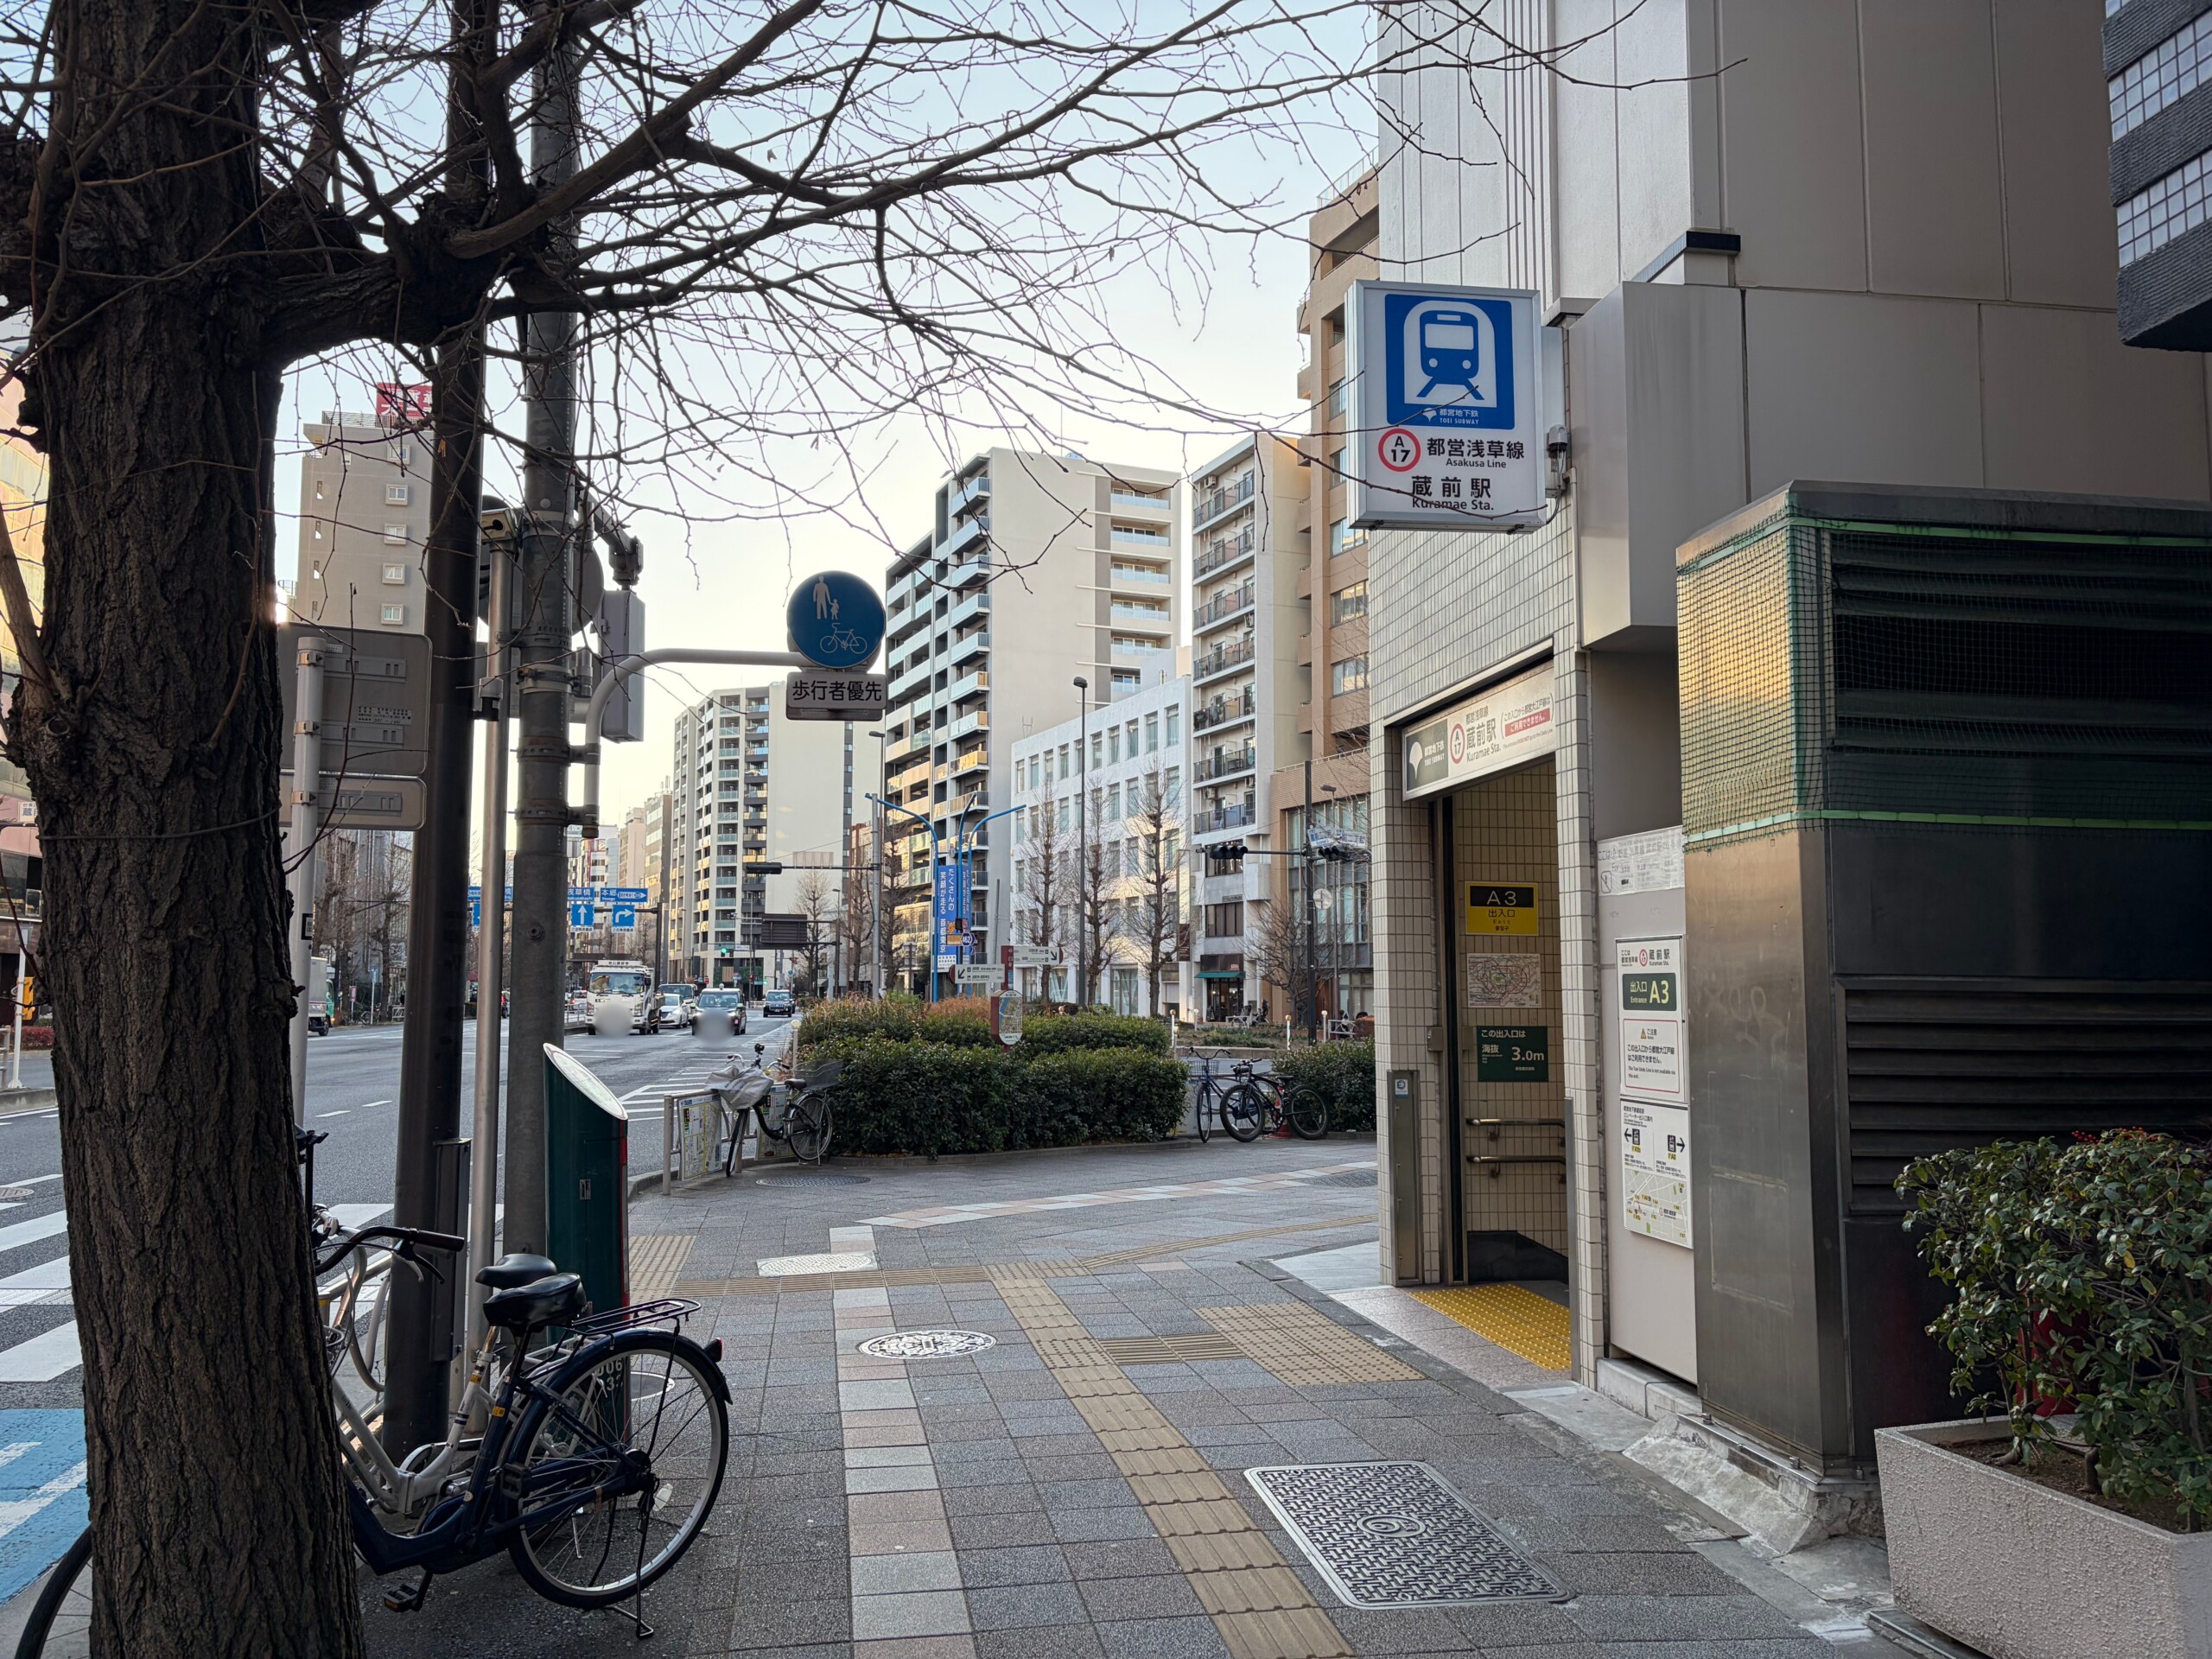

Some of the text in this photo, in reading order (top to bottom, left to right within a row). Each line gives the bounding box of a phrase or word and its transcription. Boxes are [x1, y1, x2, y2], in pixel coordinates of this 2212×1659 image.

[1440, 408, 1479, 417] 都営地下鉄
[1395, 435, 1405, 448] A
[1427, 437, 1524, 460] 都営浅草線
[1391, 449, 1410, 463] 17
[1446, 458, 1507, 468] Asakusa Line
[1411, 475, 1491, 499] 蔵前駅
[1412, 498, 1493, 511] Kuramae Sta.
[792, 680, 882, 702] 歩行者優先
[1466, 706, 1489, 725] 都営浅草線
[1455, 731, 1460, 741] A
[1467, 718, 1497, 750] 蔵前駅
[1454, 743, 1461, 755] 17
[1467, 743, 1501, 762] Kuramae Sta.
[1486, 890, 1516, 906] A3
[1488, 909, 1516, 918] 出入口
[1649, 949, 1669, 960] 蔵前駅
[1630, 981, 1648, 993] 出入口
[1649, 980, 1669, 1004] A3
[1481, 1030, 1526, 1039] この出入口は
[1482, 1044, 1499, 1054] 海抜
[1511, 1046, 1545, 1061] 3.0m
